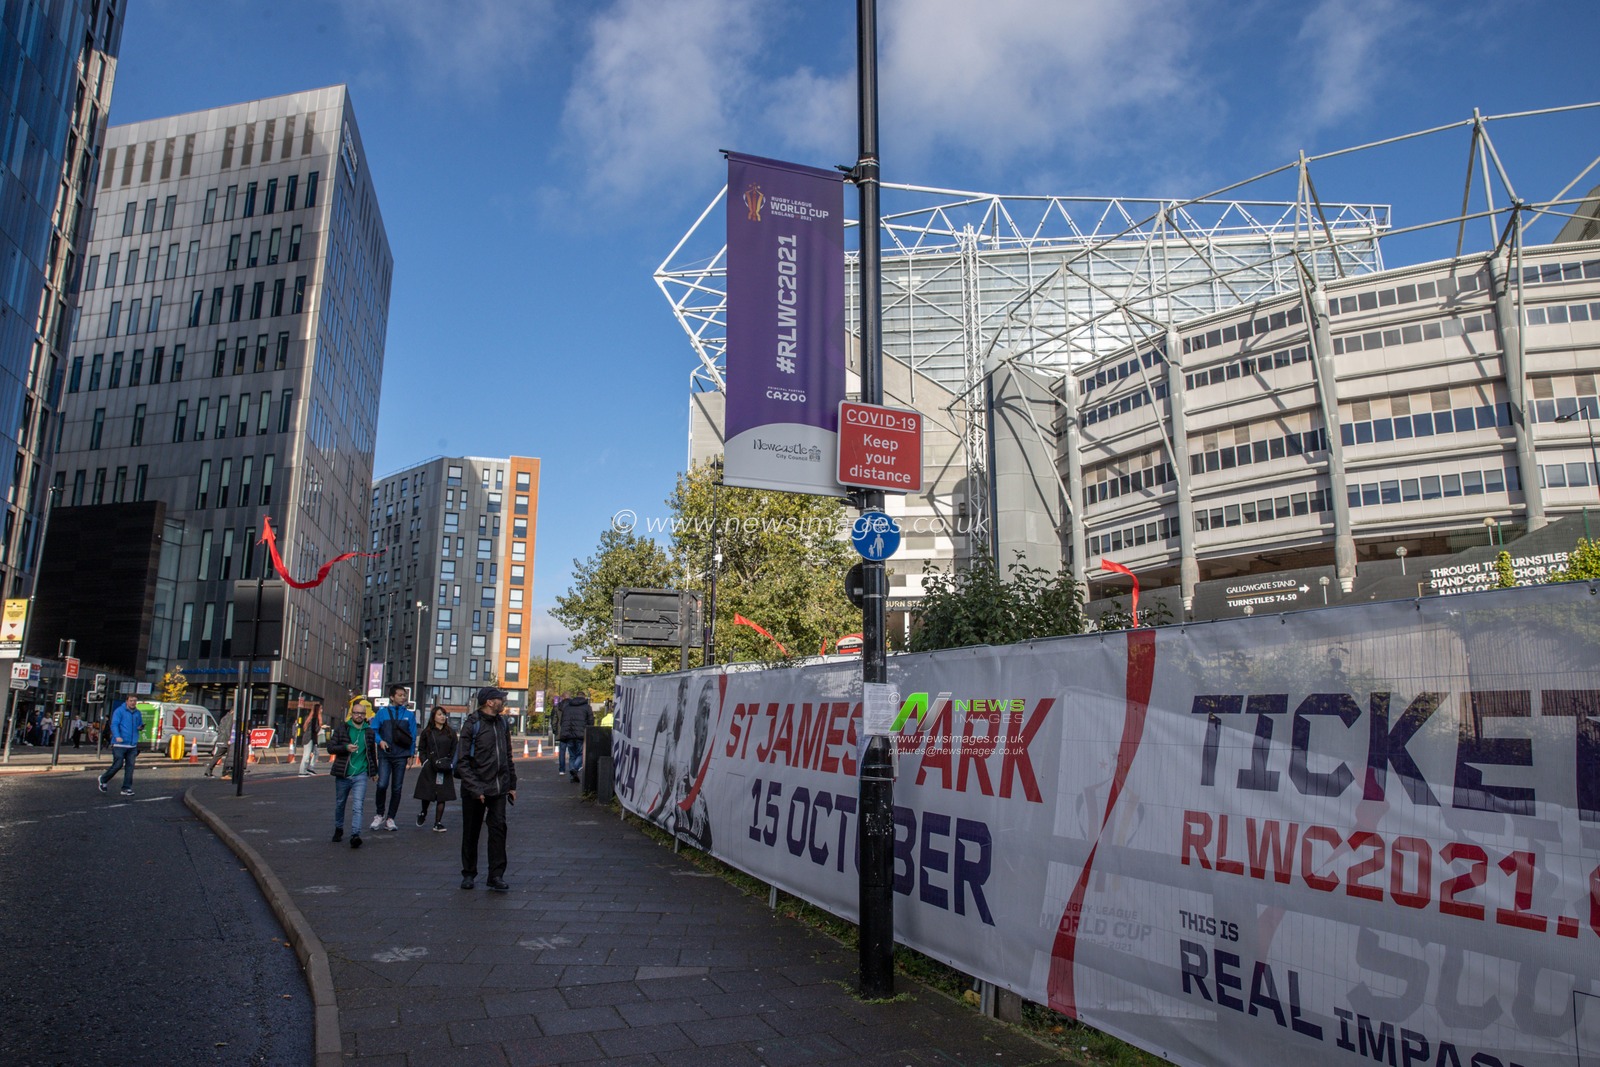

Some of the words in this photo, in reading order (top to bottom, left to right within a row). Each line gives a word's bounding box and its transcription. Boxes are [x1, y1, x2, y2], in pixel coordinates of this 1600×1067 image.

[770, 201, 806, 215] WORLD
[808, 208, 829, 219] CUP
[771, 196, 790, 204] RUGBY
[791, 199, 812, 208] LEAGUE
[771, 210, 795, 219] ENGLAND
[776, 234, 797, 374] #RLWC2021
[766, 390, 806, 403] CAZOO
[846, 408, 917, 430] COVID-19
[753, 438, 808, 455] Newcastle
[863, 433, 899, 451] Keep
[865, 452, 897, 468] your
[849, 465, 911, 485] distance
[1430, 563, 1480, 578] THROUGH
[1483, 561, 1498, 572] TH
[1510, 551, 1568, 568] URNSTILES
[1513, 565, 1546, 578] CHOIR
[1226, 582, 1272, 594] GALLOWGATE
[1272, 579, 1296, 589] STAND
[1227, 595, 1275, 607] TURNSTILES
[1275, 593, 1297, 602] 74-50
[188, 713, 202, 728] dpd
[725, 703, 761, 759] ST
[757, 701, 864, 777] JAMES
[893, 697, 1057, 804] PARK
[749, 778, 782, 847] 15
[786, 787, 996, 927] OCTBER
[1180, 809, 1600, 940] RLWC2021.
[1178, 910, 1216, 936] THIS
[1219, 919, 1239, 942] IS
[1178, 938, 1323, 1042] REAL
